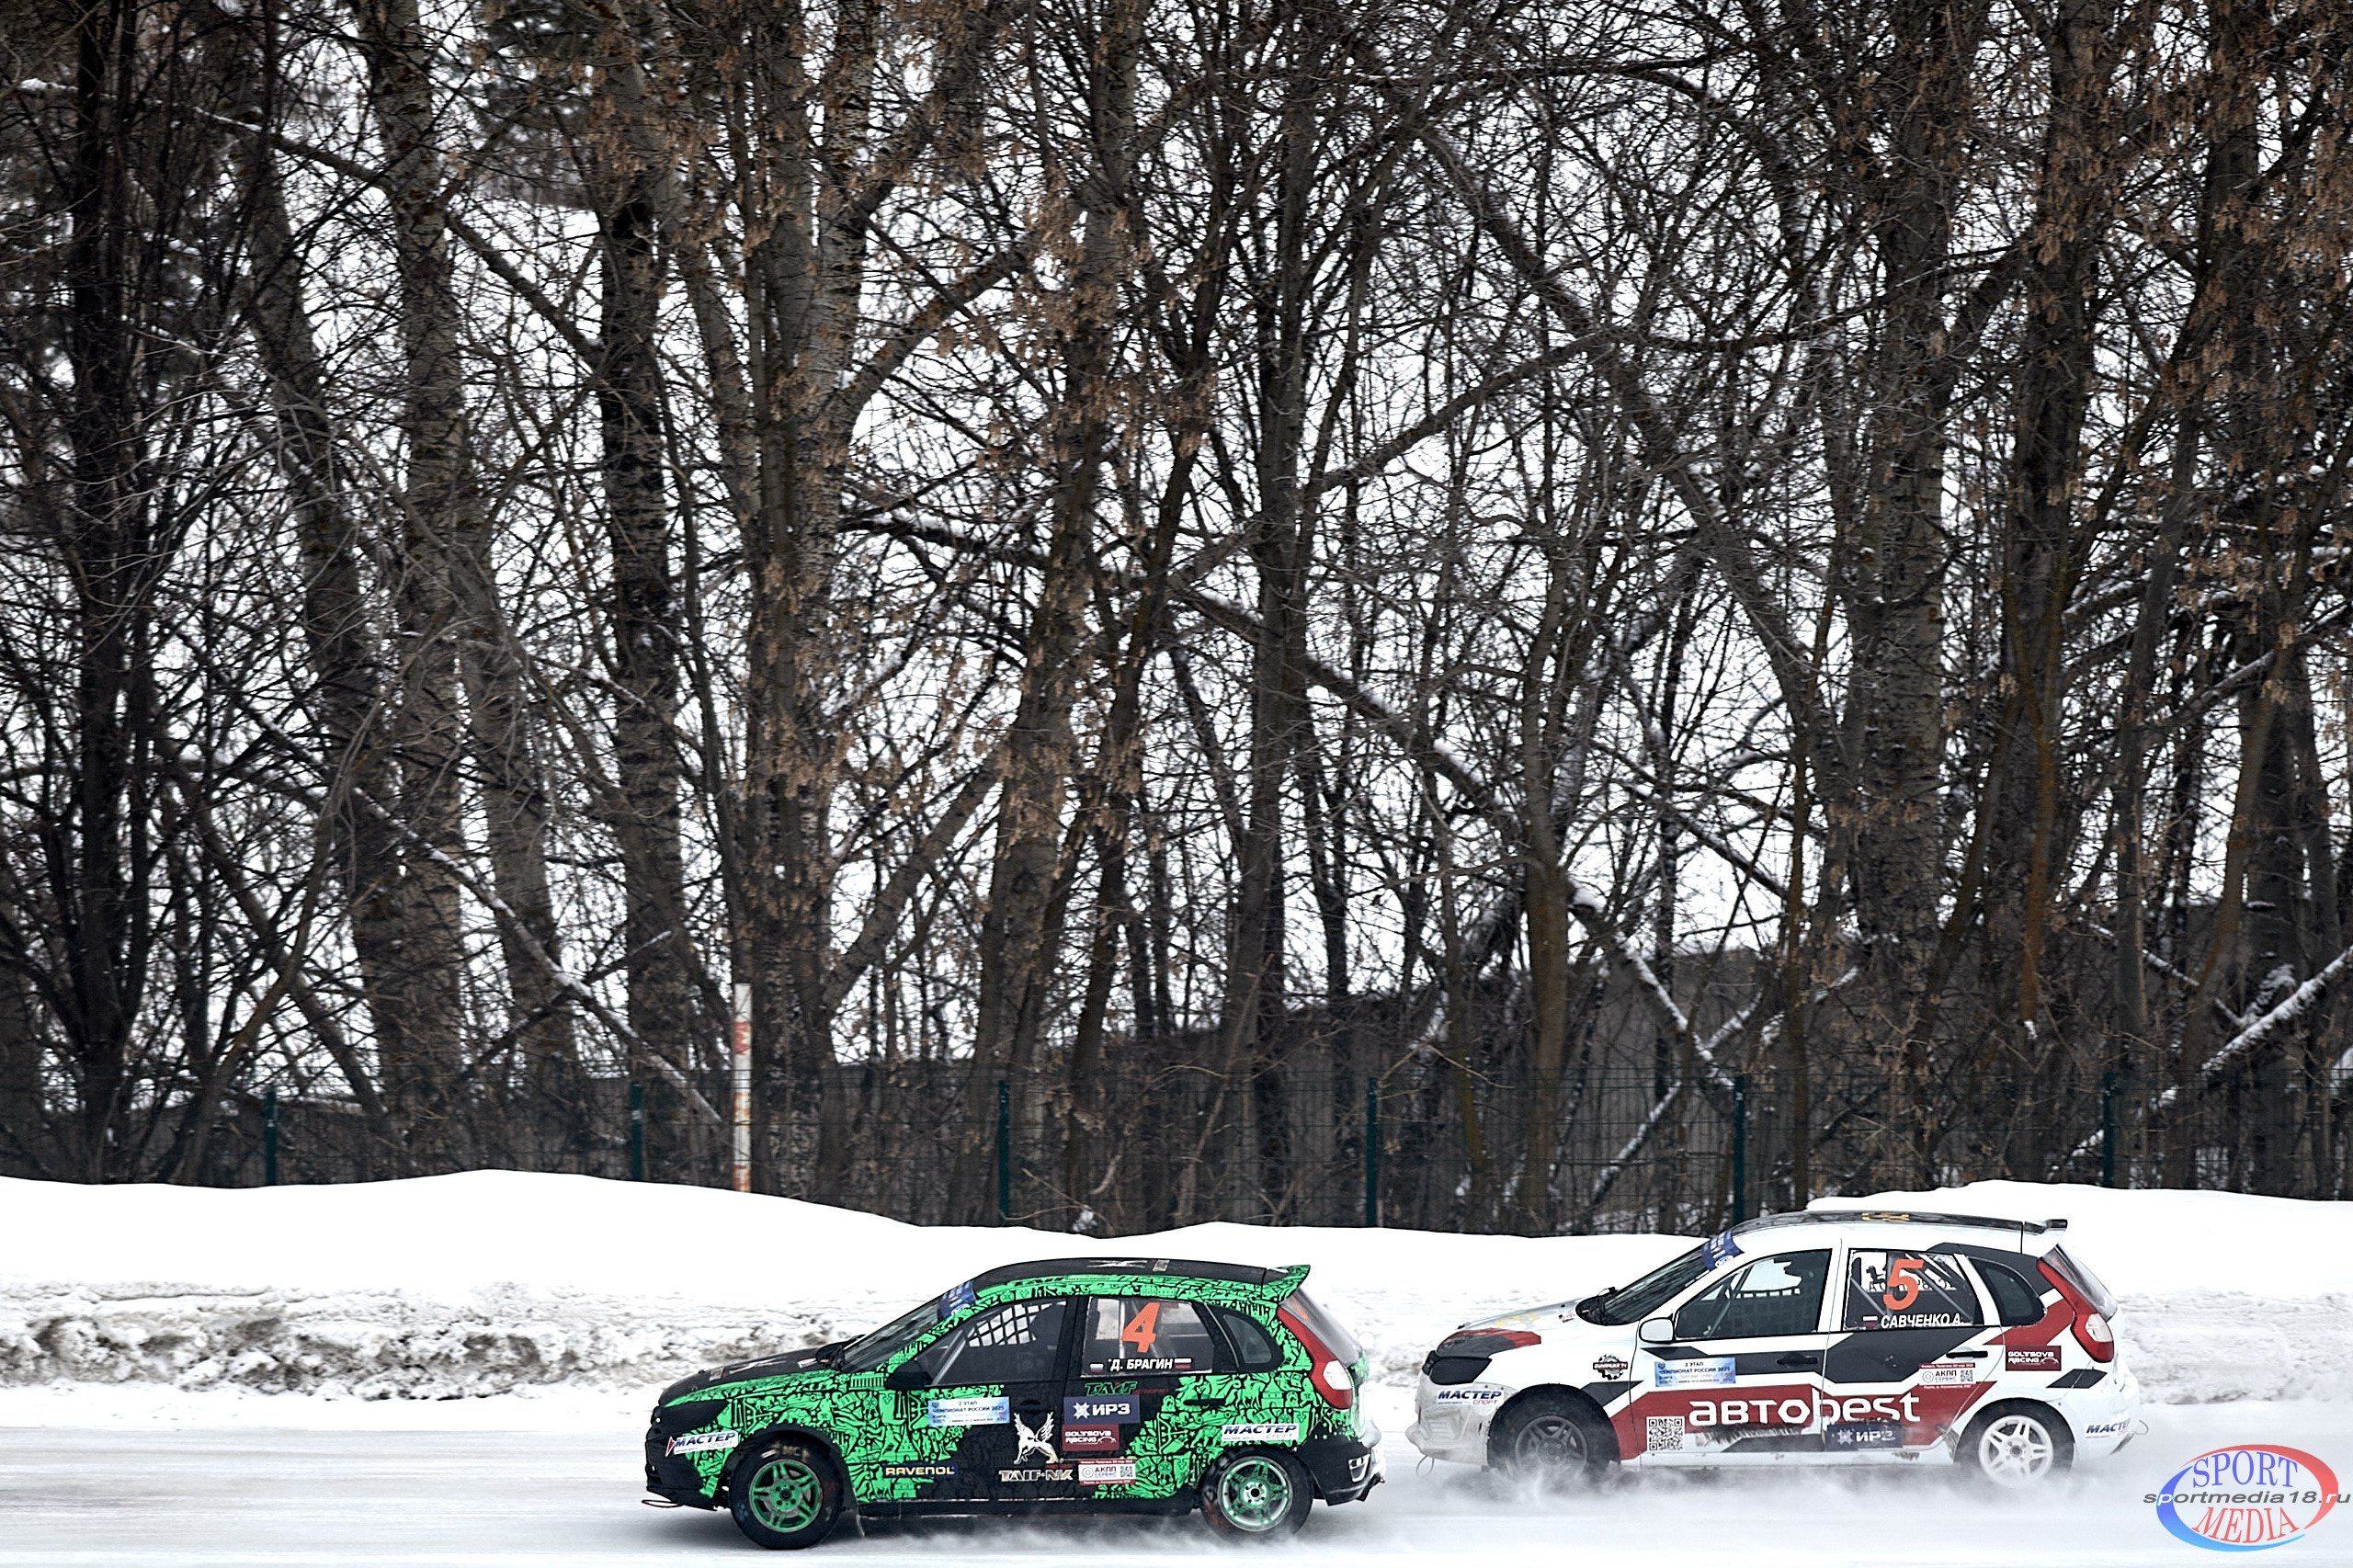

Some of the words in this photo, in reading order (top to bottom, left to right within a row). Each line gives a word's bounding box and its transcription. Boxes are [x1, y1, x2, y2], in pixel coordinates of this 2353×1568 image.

[1882, 1258, 1925, 1311] 5
[1121, 1301, 1160, 1353] 4
[1881, 1314, 1950, 1329] САВЧЕНКО
[1126, 1358, 1174, 1369] БРАГИН
[1438, 1391, 1502, 1399] МАСТЕР
[1092, 1403, 1131, 1416] ИРЗ
[1224, 1426, 1297, 1434] МАСТЕР
[1856, 1430, 1896, 1442] ИРЗ
[675, 1432, 735, 1448] МАСТЕР
[885, 1466, 955, 1475] RAVENOL
